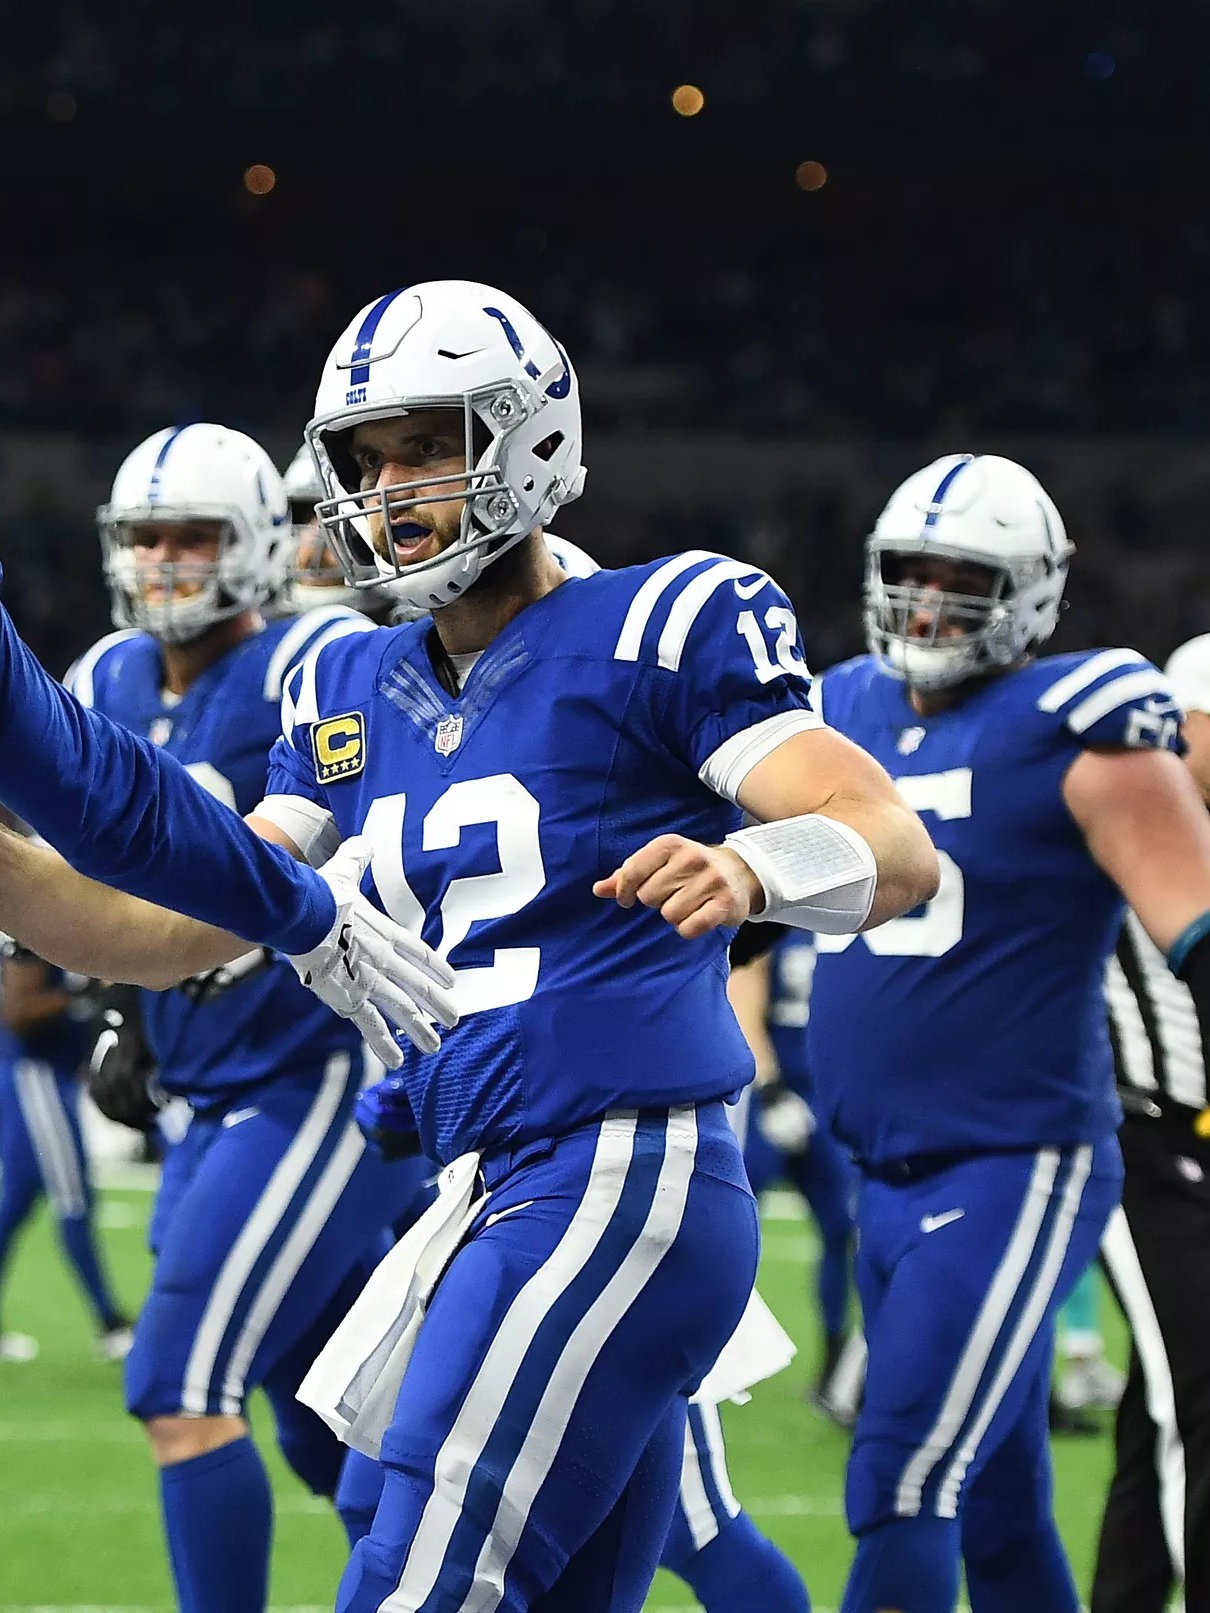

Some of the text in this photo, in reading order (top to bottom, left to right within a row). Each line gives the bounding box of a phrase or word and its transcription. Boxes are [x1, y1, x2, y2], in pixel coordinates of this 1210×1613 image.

[736, 606, 814, 685] 12
[316, 717, 361, 766] C
[361, 773, 546, 1028] 12
